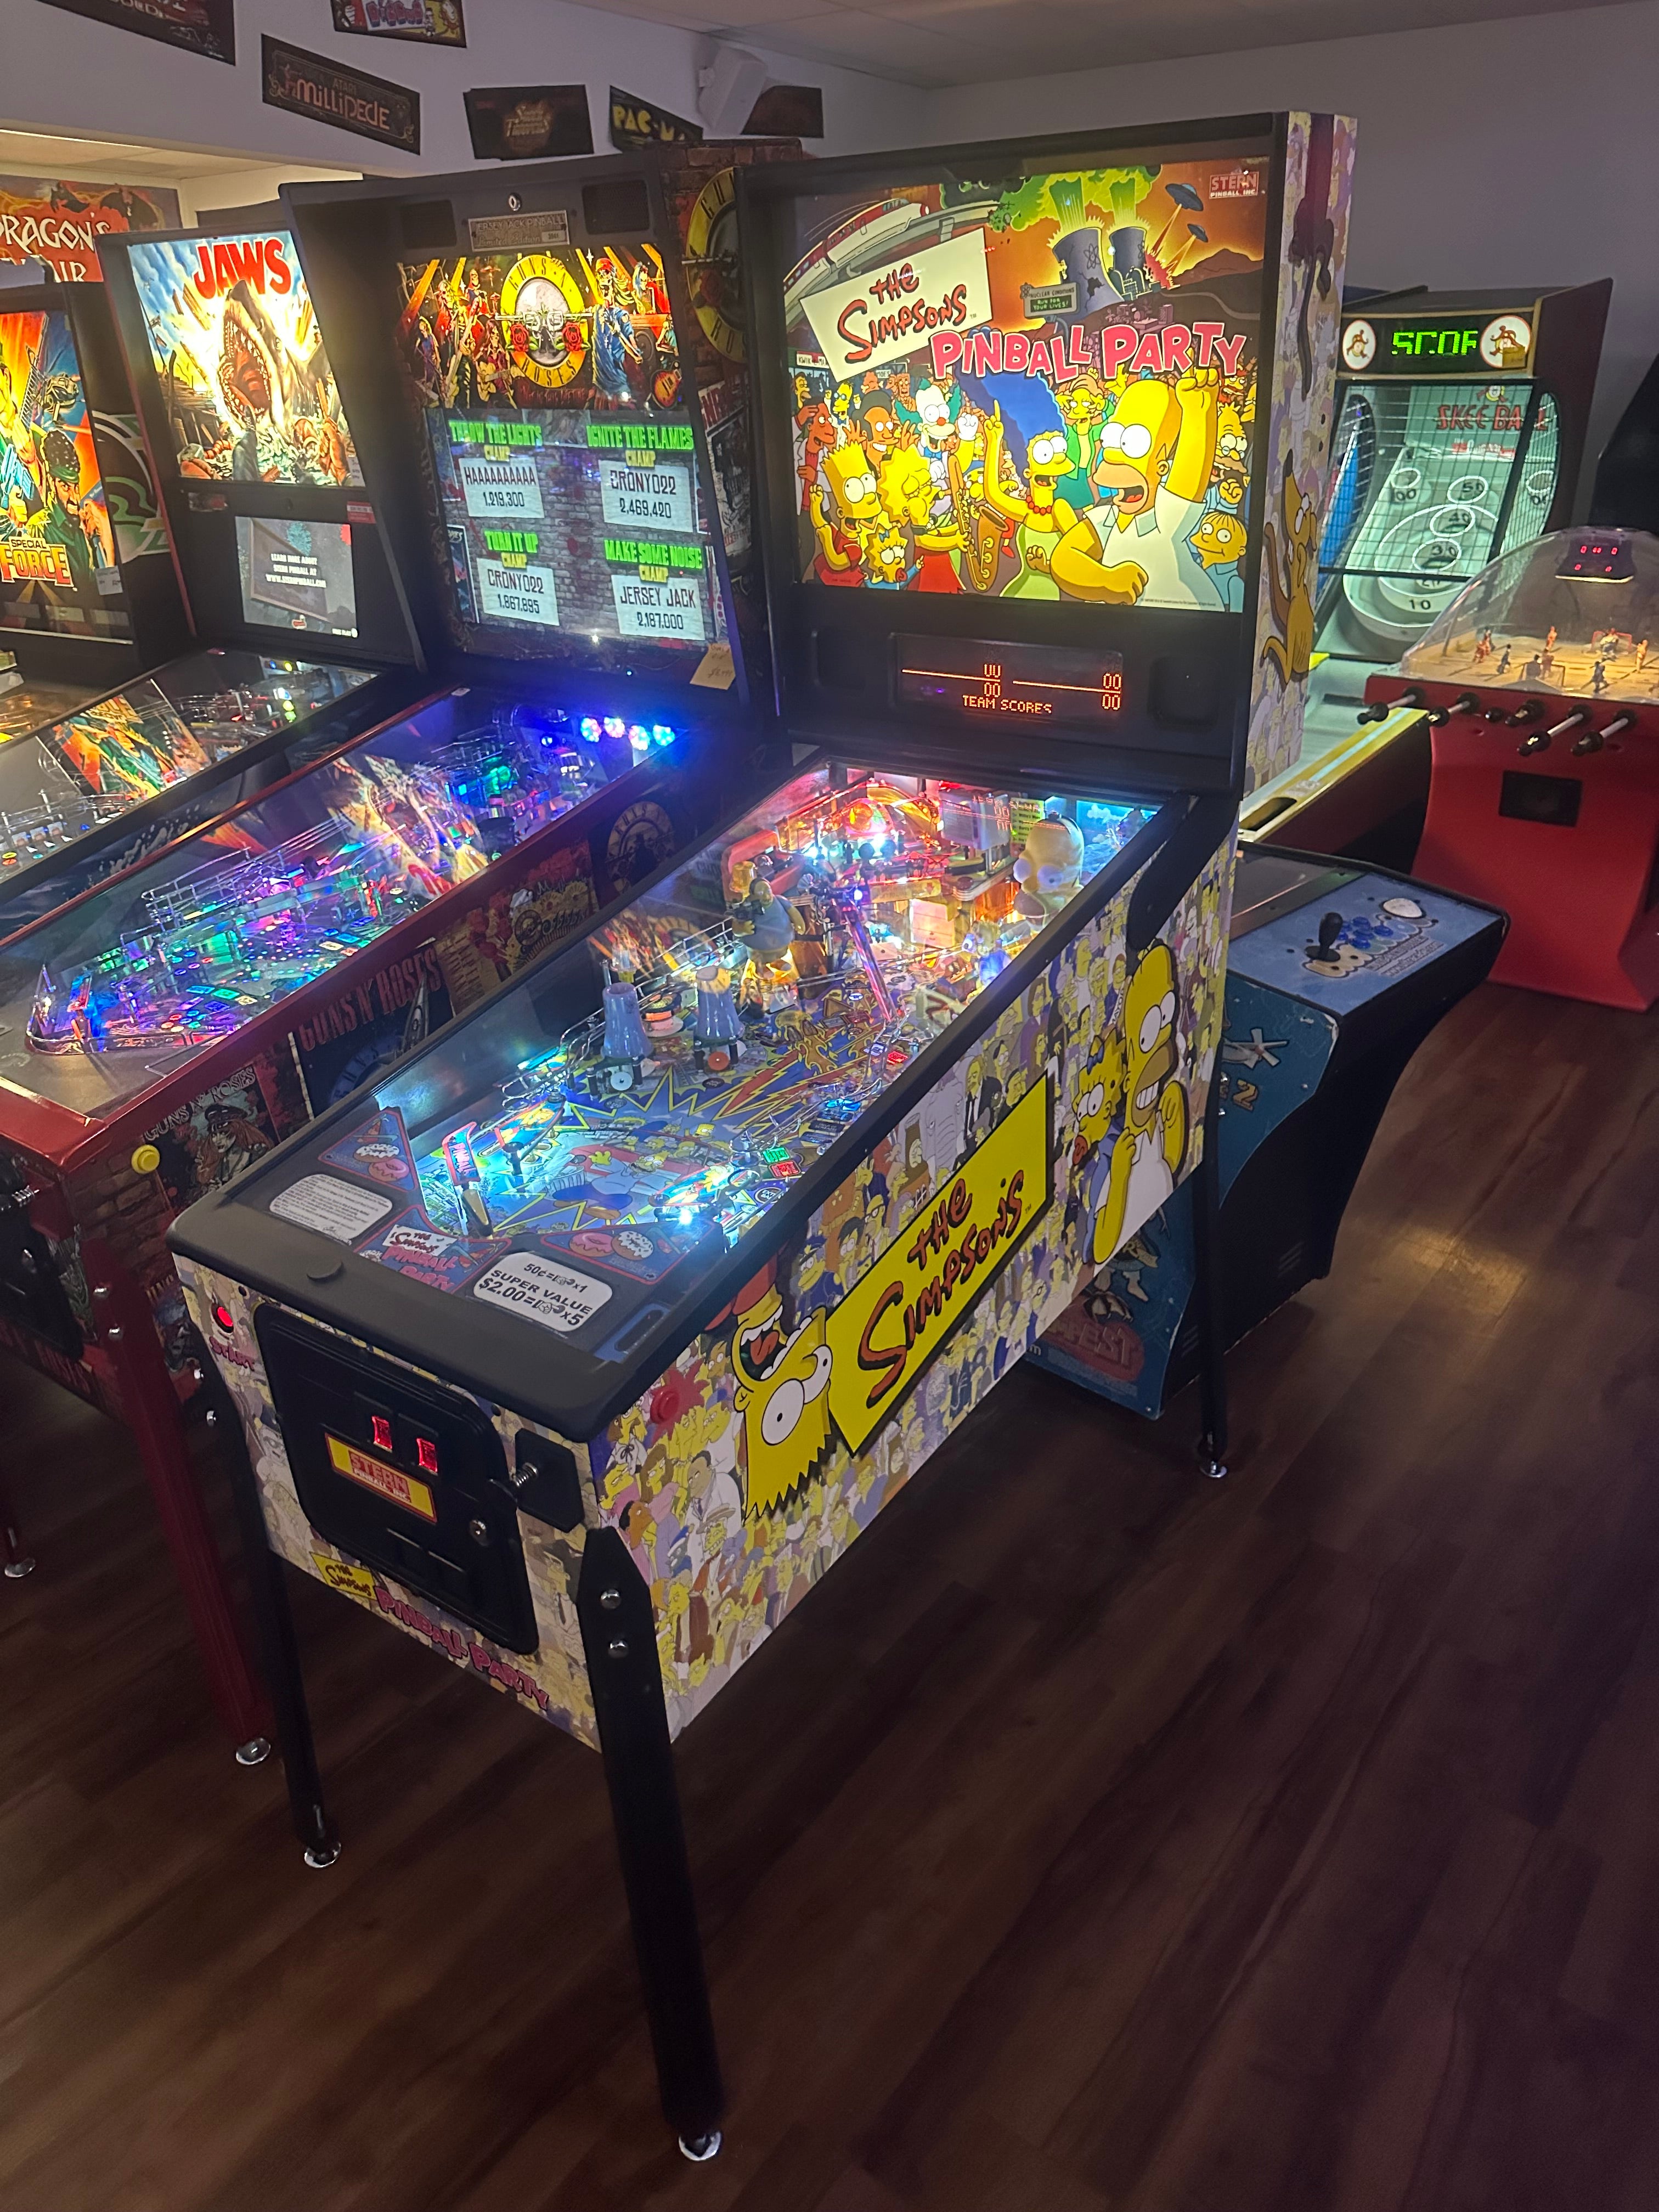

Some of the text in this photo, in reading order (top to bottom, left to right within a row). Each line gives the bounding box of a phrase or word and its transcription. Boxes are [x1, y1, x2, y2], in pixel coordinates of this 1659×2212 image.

[1212, 173, 1257, 191] STERN
[193, 237, 291, 300] JAWS
[508, 257, 546, 291] GUNS
[1049, 300, 1069, 309] LIVES!
[930, 321, 1247, 383] PINBALL PARTY
[522, 359, 577, 388] ROSES
[1493, 404, 1548, 431] BAL
[450, 421, 542, 446] THROW THE LIGHTS
[587, 425, 694, 450] IGNITE THE FLAMES
[484, 445, 510, 462] CHAMP
[625, 450, 656, 467] CHAMP
[11, 539, 47, 549] SPECIAL
[485, 531, 512, 552] TURN
[512, 532, 523, 552] IT
[524, 533, 538, 554] UP
[605, 539, 703, 569] MAKE SOME NOISE
[1431, 545, 1457, 555] 30
[0, 544, 74, 586] FORCE
[501, 552, 527, 568] CHAMP
[639, 565, 669, 583] CHAMP
[620, 585, 697, 609] JERSEY JACK
[1409, 600, 1431, 610] 10
[983, 682, 1002, 698] 00
[1102, 673, 1122, 690] 00
[962, 694, 1053, 714] TEAM SCORES
[1101, 693, 1121, 710] 00
[298, 997, 358, 1052] GUNS
[378, 939, 441, 1015] ROSES
[144, 1102, 191, 1142] GUNS
[209, 1066, 256, 1104] ROSES
[449, 1142, 477, 1176] PINBALL
[382, 1245, 459, 1272] PINBALL
[490, 1269, 593, 1315] SUPER VALUE
[210, 1336, 255, 1370] START
[351, 1453, 409, 1495] STERN
[374, 1585, 549, 1711] PINBALL PARTY
